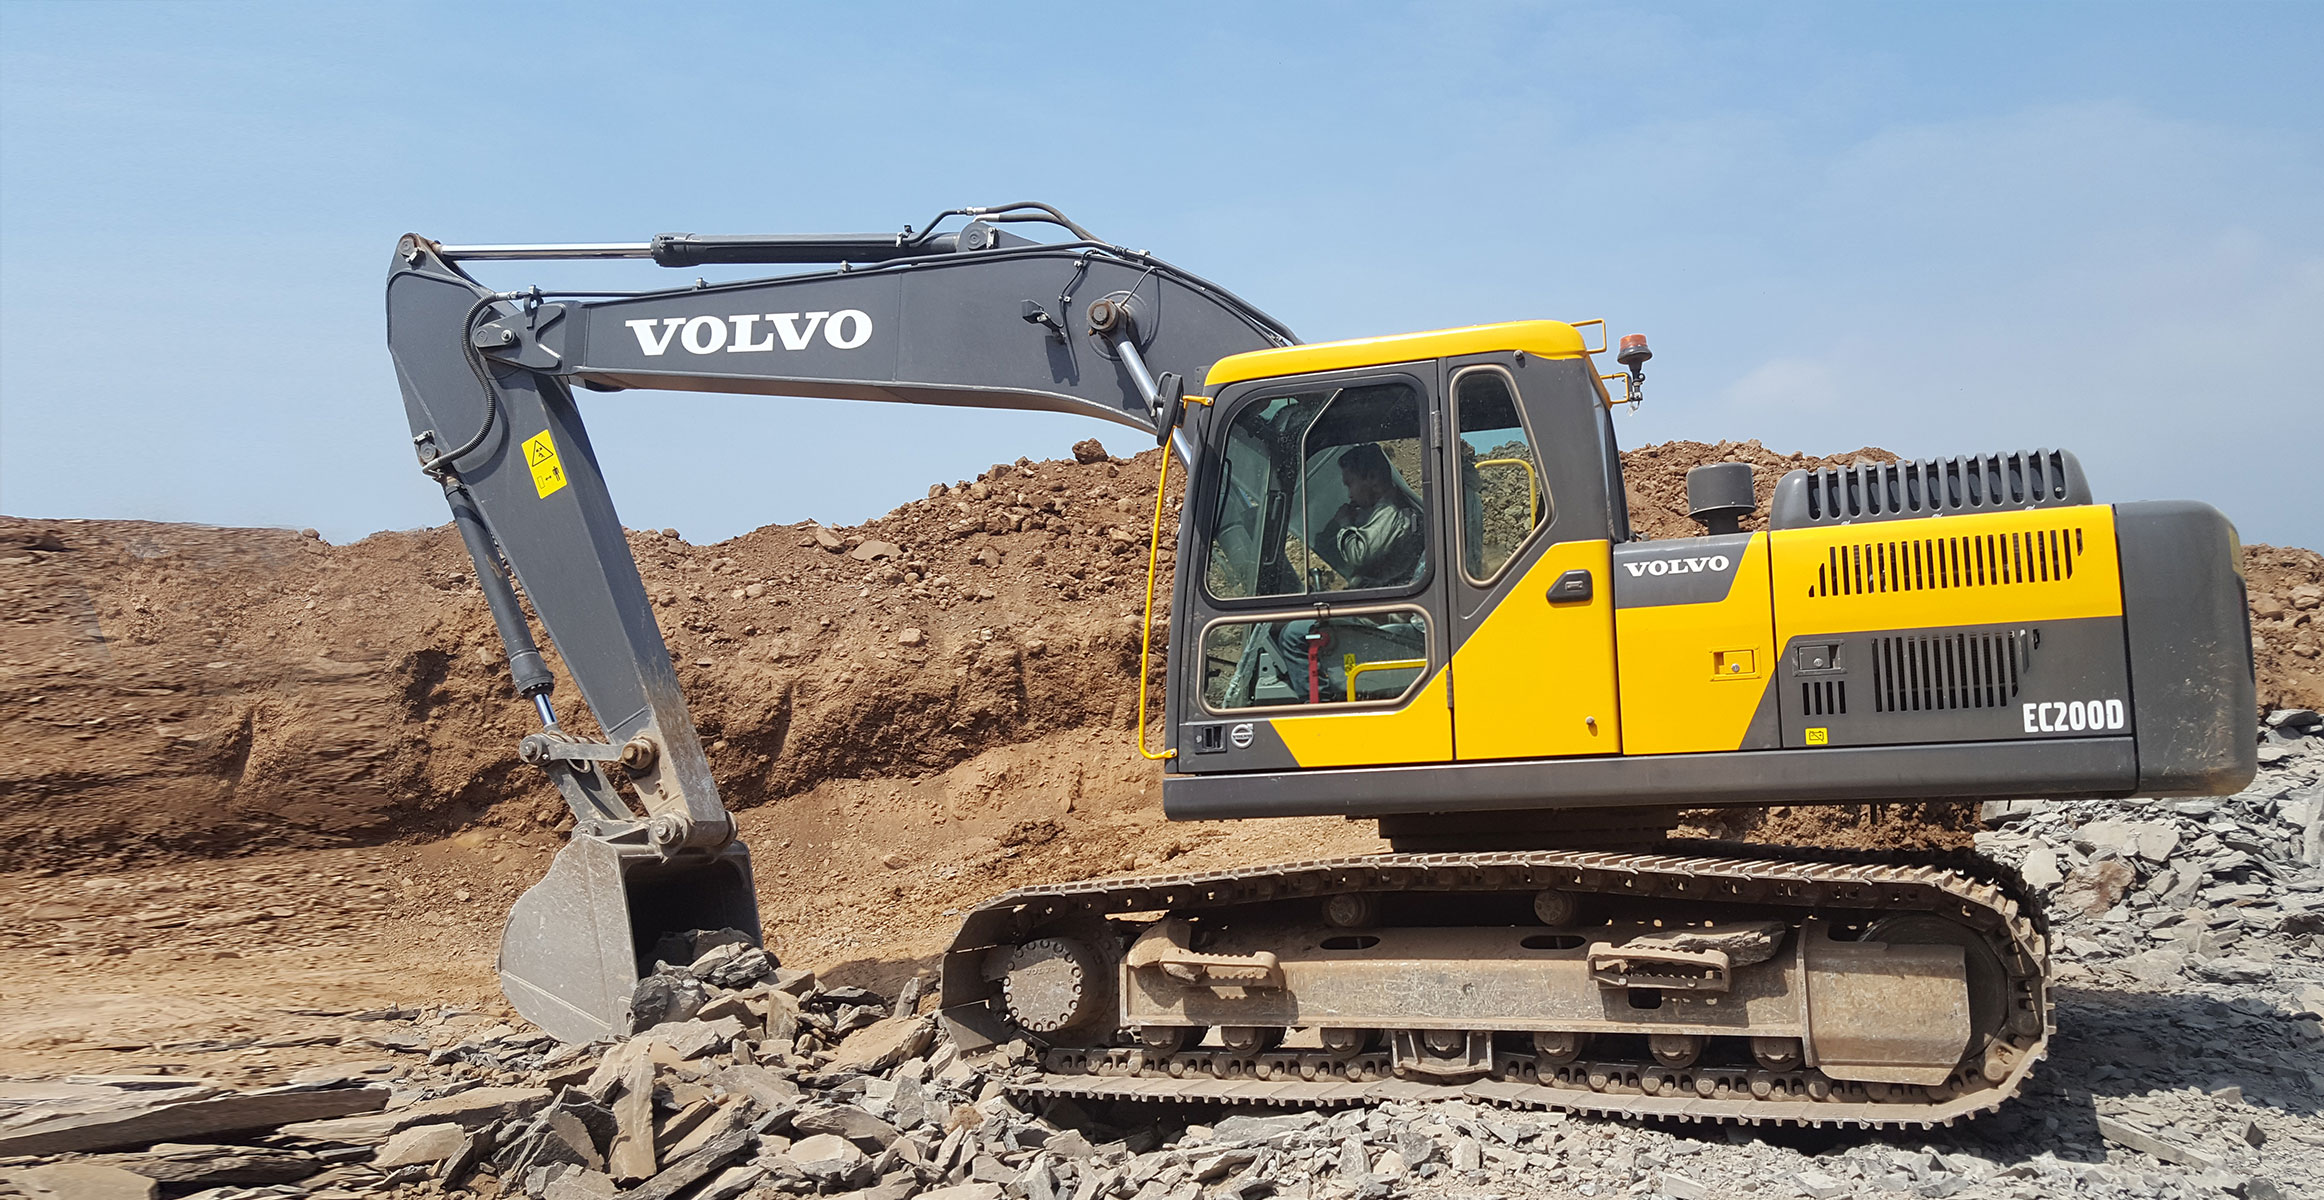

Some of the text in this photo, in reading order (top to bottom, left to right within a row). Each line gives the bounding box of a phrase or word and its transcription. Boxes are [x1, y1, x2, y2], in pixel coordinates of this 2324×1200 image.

[625, 309, 873, 356] VOLVO
[1623, 555, 1730, 577] VOLVO
[2022, 699, 2125, 733] EC200D
